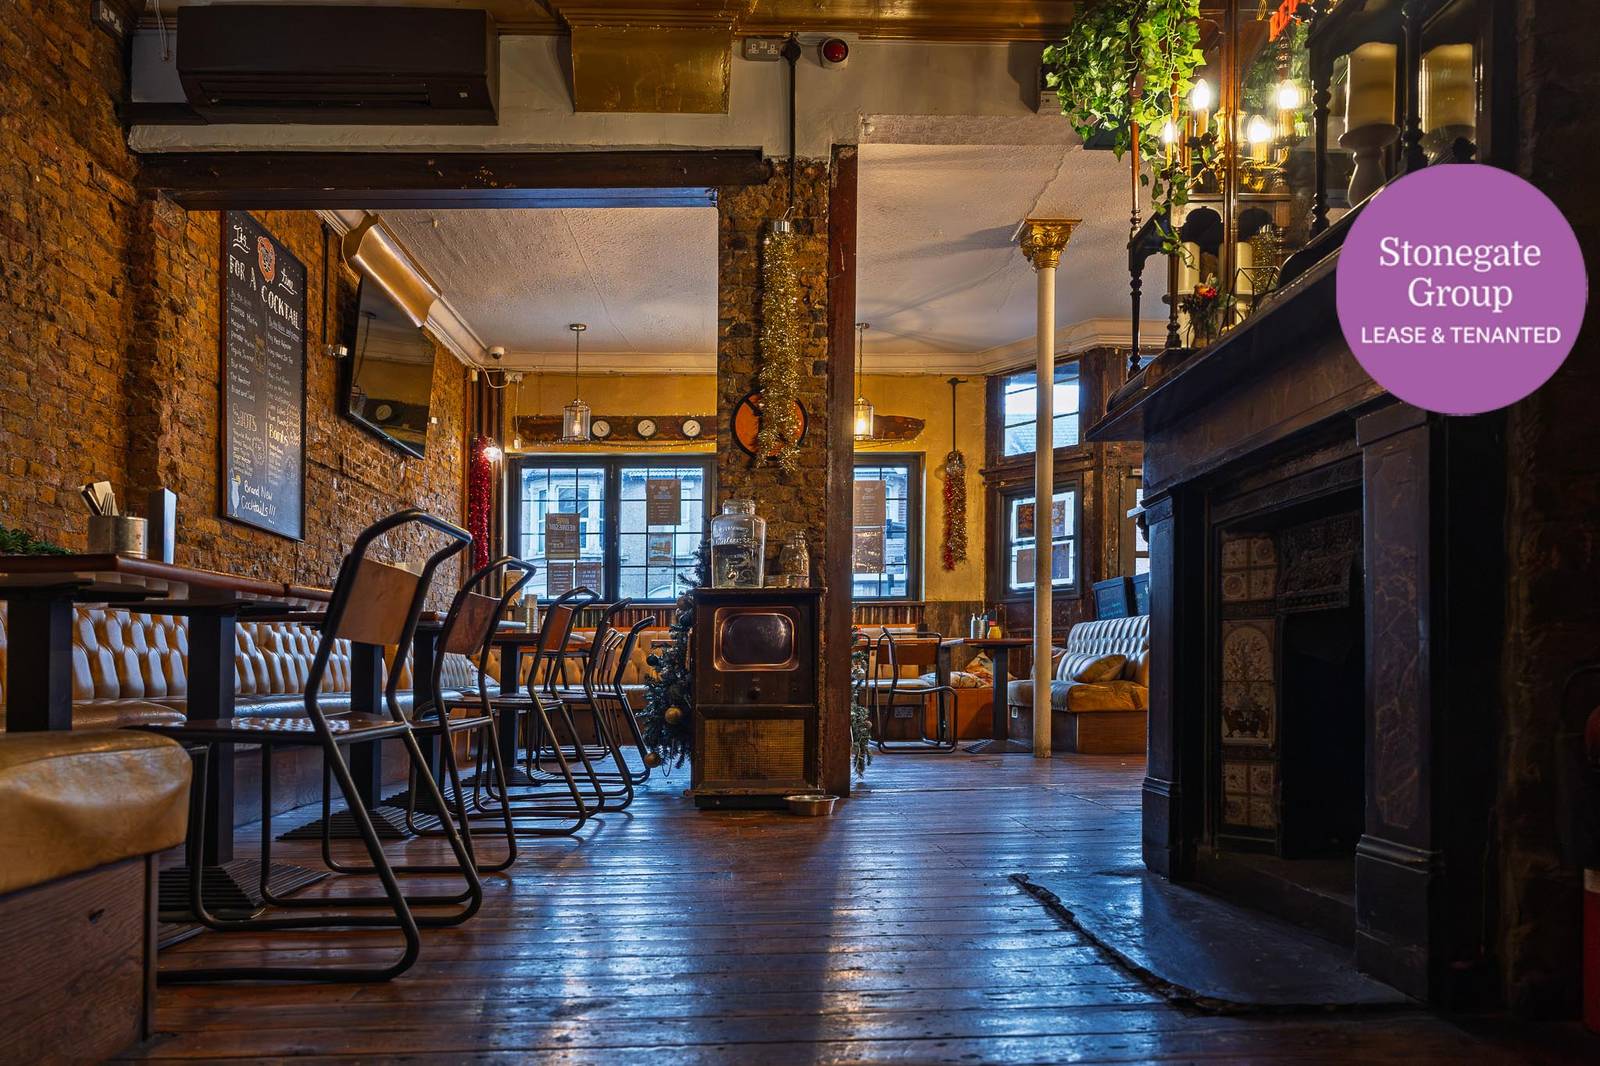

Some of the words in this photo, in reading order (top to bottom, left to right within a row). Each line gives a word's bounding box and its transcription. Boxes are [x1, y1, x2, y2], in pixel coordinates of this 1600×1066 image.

[229, 254, 246, 282] FOR
[249, 266, 257, 291] A
[261, 285, 300, 331] COCKTAIL
